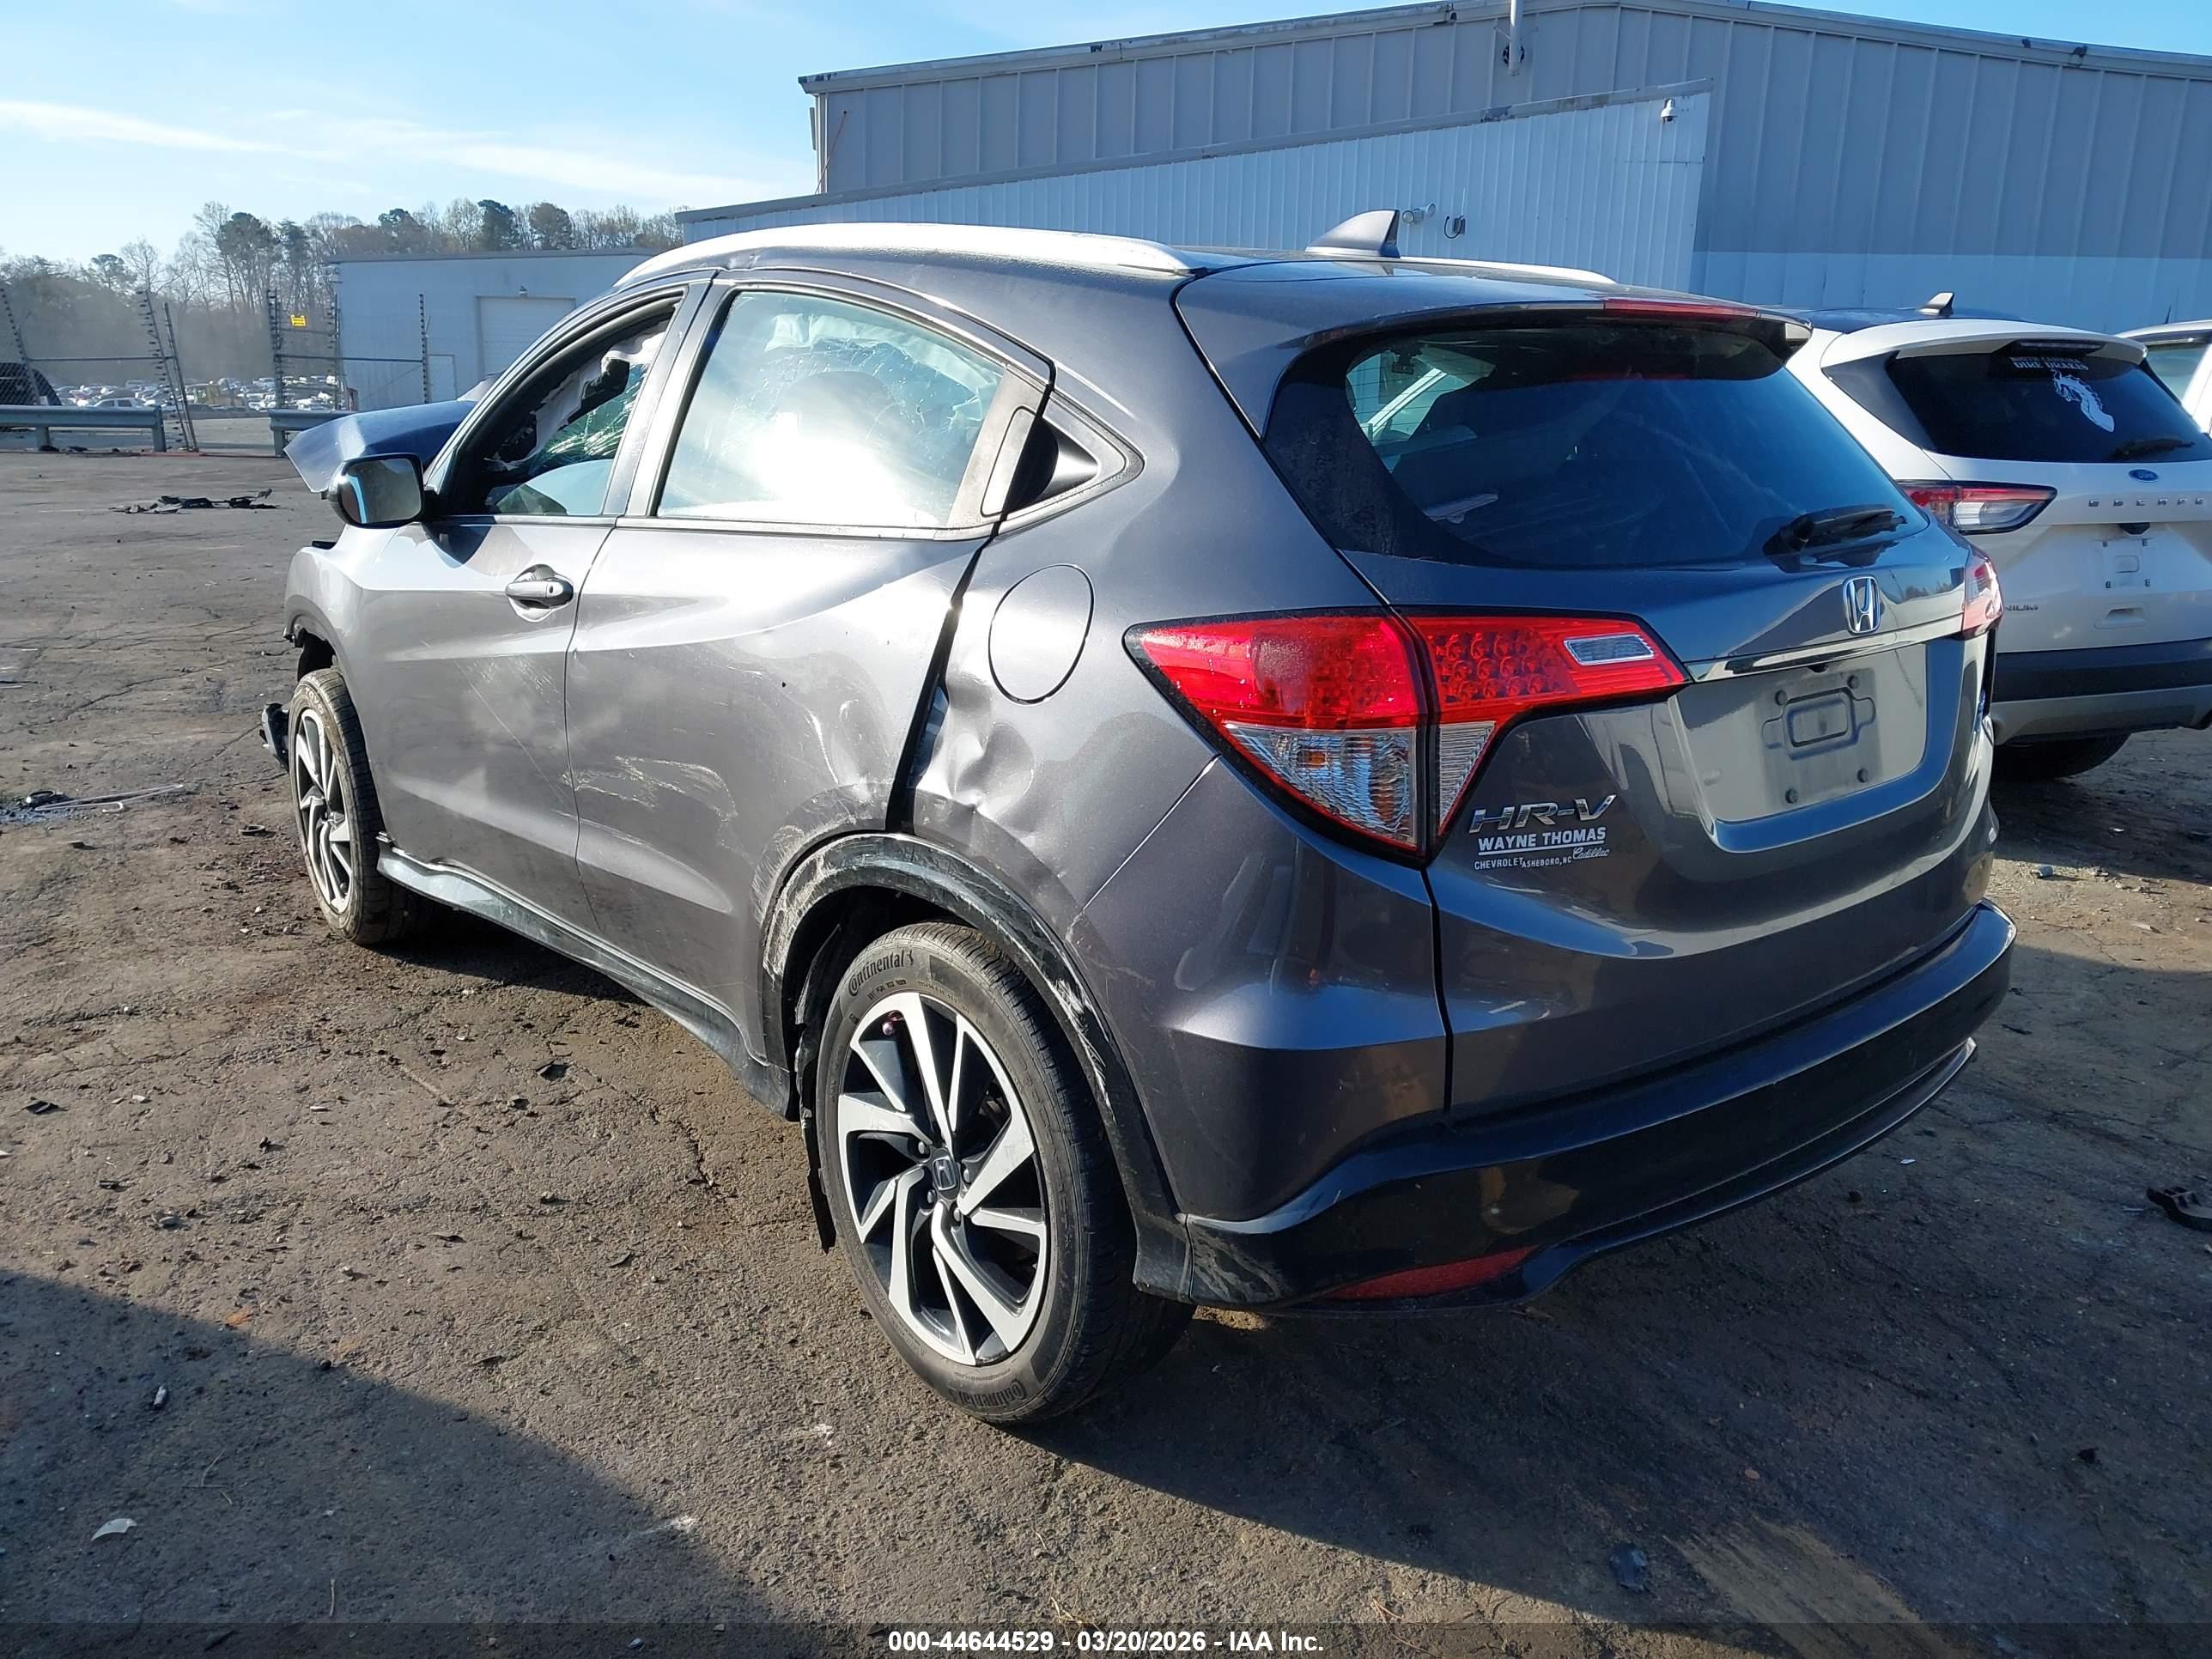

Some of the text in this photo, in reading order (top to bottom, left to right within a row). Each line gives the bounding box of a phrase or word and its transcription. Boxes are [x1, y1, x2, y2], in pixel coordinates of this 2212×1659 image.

[2088, 497, 2205, 507] ESCAPE
[1468, 794, 1617, 834] HR-V
[1478, 826, 1607, 852] WAYNE THOMAS
[1474, 857, 1523, 871] CHEVROLET
[1572, 845, 1611, 860] Cadillac
[848, 950, 906, 997] Continental
